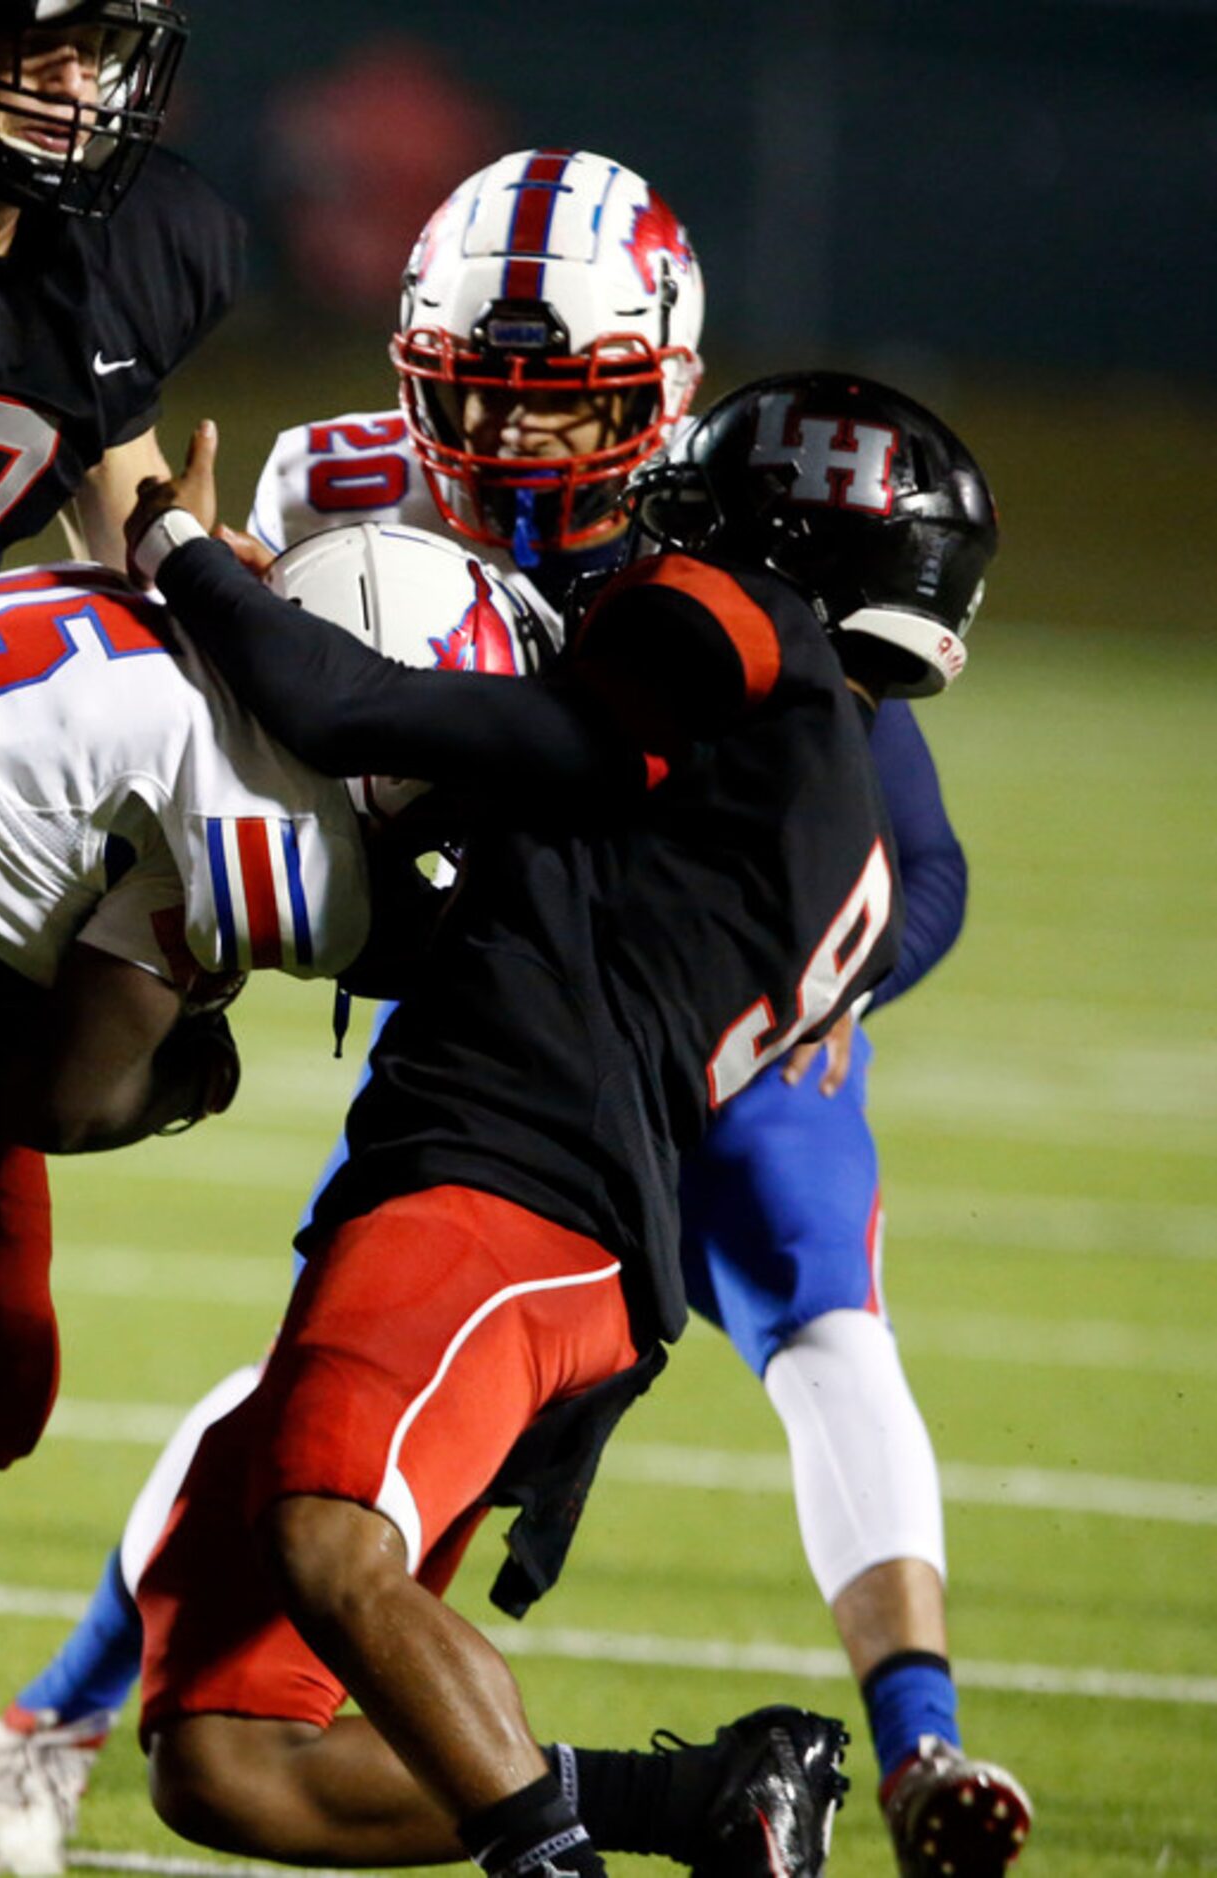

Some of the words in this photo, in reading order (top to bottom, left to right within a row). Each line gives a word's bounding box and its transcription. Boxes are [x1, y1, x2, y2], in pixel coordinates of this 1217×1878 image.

[305, 418, 411, 515] 20
[749, 394, 900, 516] LH
[705, 836, 892, 1110] 9
